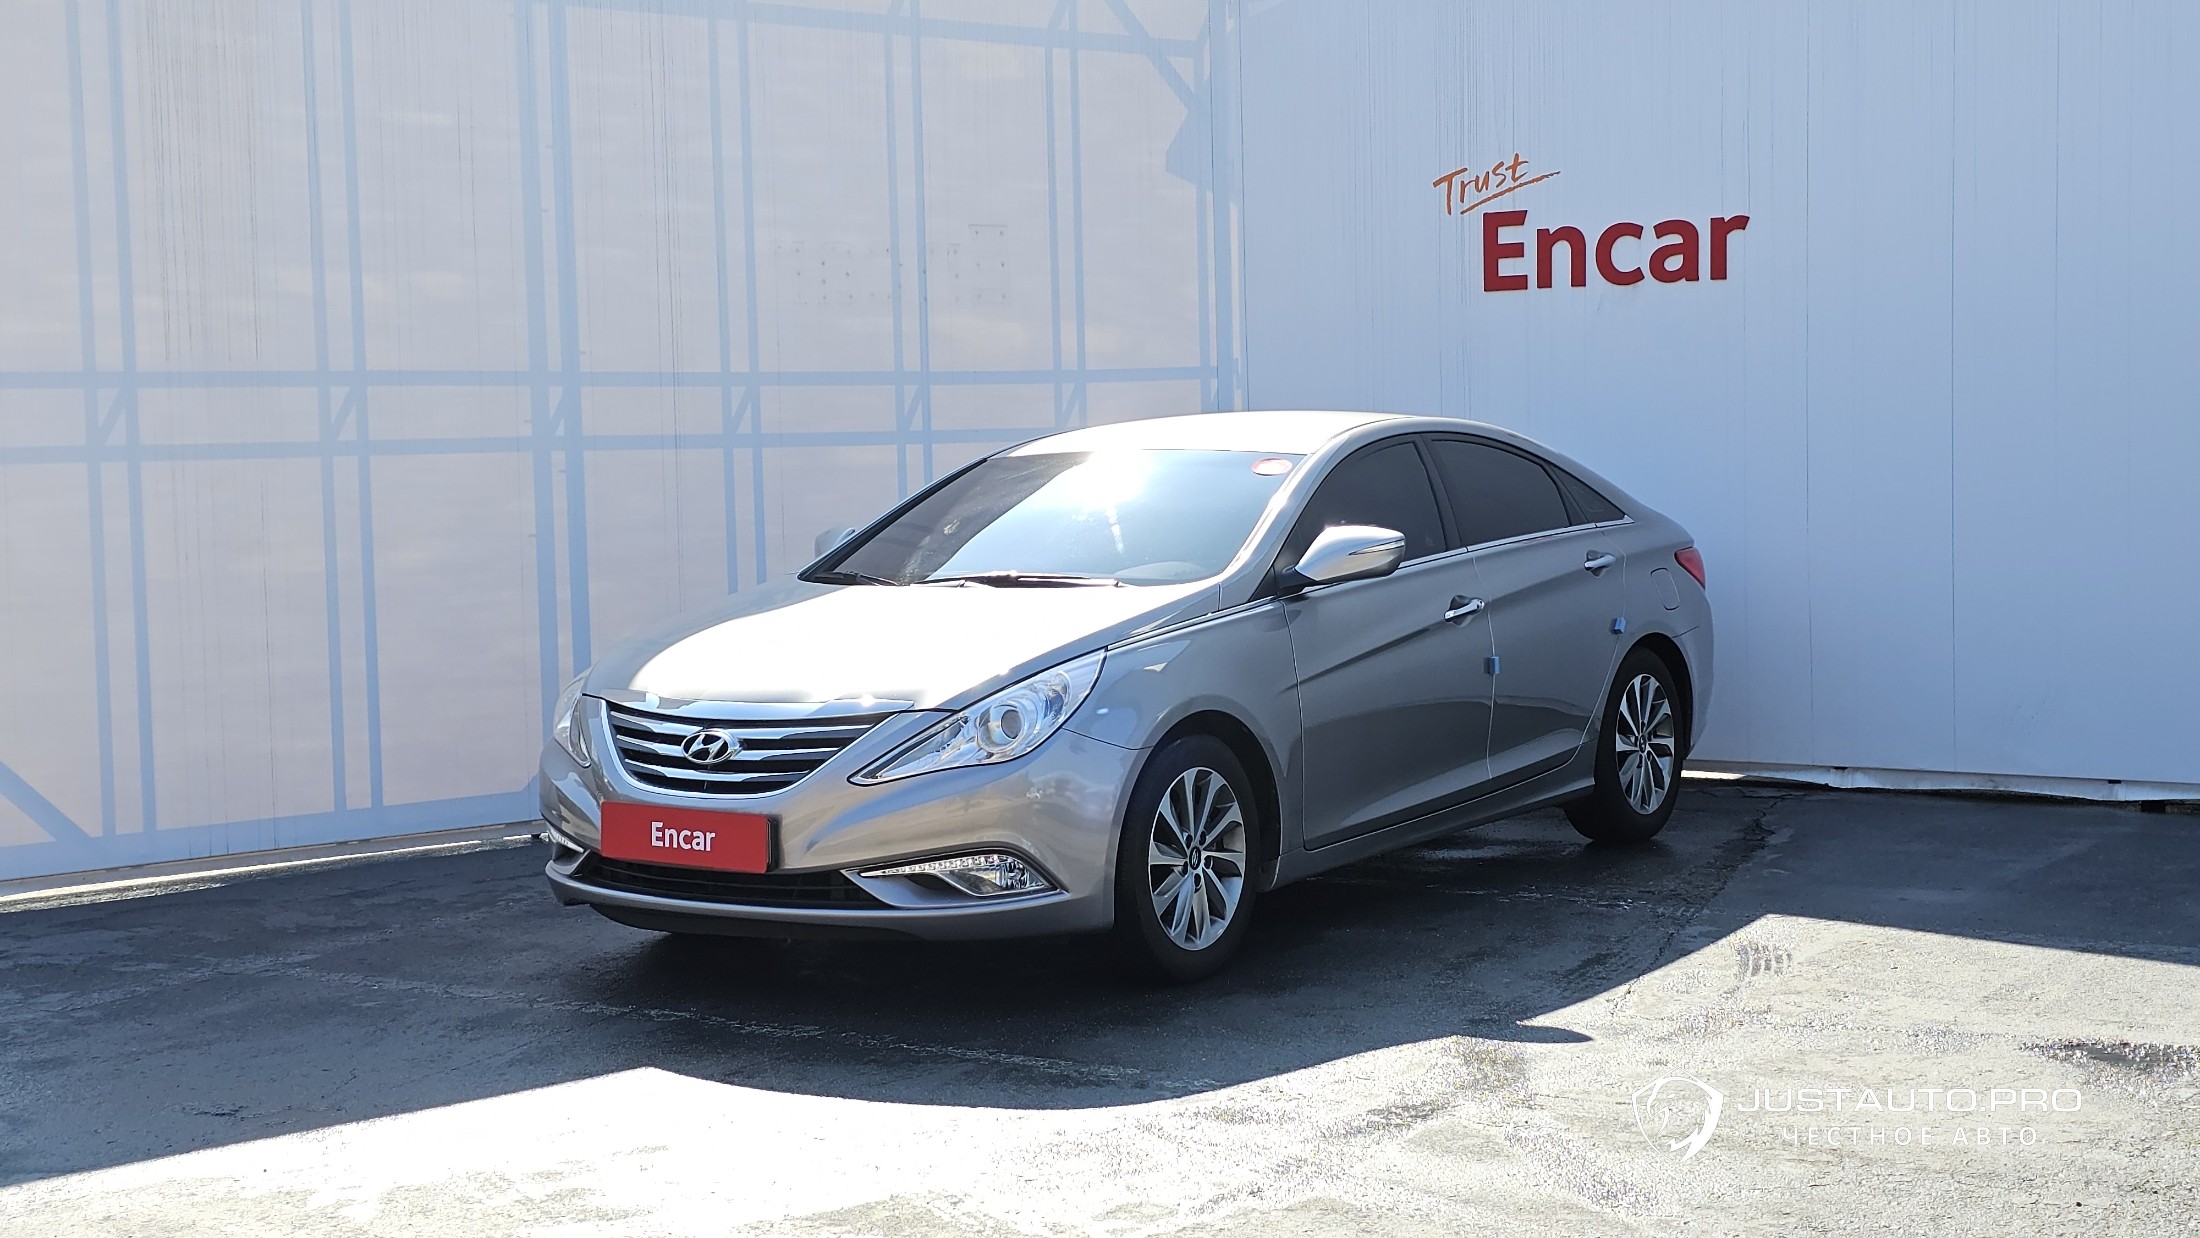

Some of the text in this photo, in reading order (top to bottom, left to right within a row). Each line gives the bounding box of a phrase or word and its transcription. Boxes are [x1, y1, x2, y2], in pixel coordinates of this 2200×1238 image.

[1433, 152, 1530, 215] Trust
[1483, 209, 1751, 292] Encar
[651, 821, 716, 852] Encar
